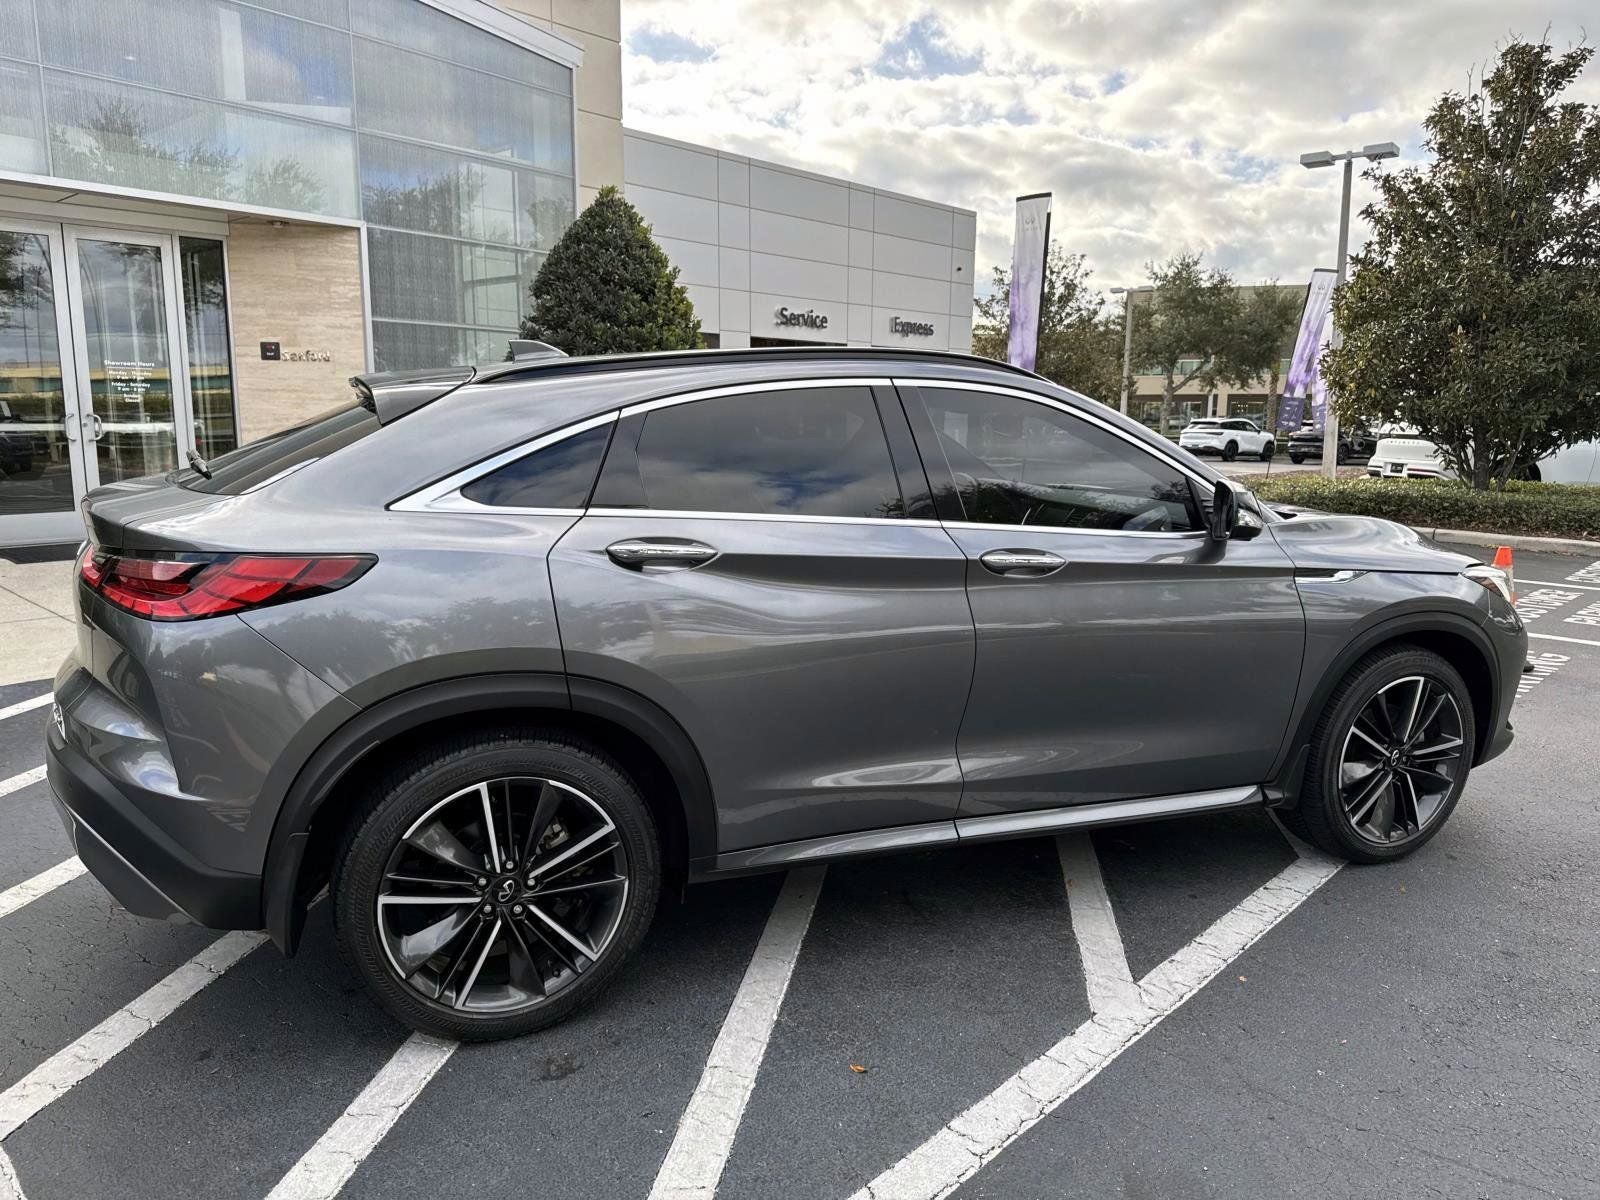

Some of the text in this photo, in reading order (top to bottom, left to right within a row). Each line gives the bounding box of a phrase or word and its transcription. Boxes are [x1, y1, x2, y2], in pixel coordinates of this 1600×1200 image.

[776, 307, 828, 329] Service
[890, 316, 934, 336] Express
[281, 350, 331, 362] Sanford
